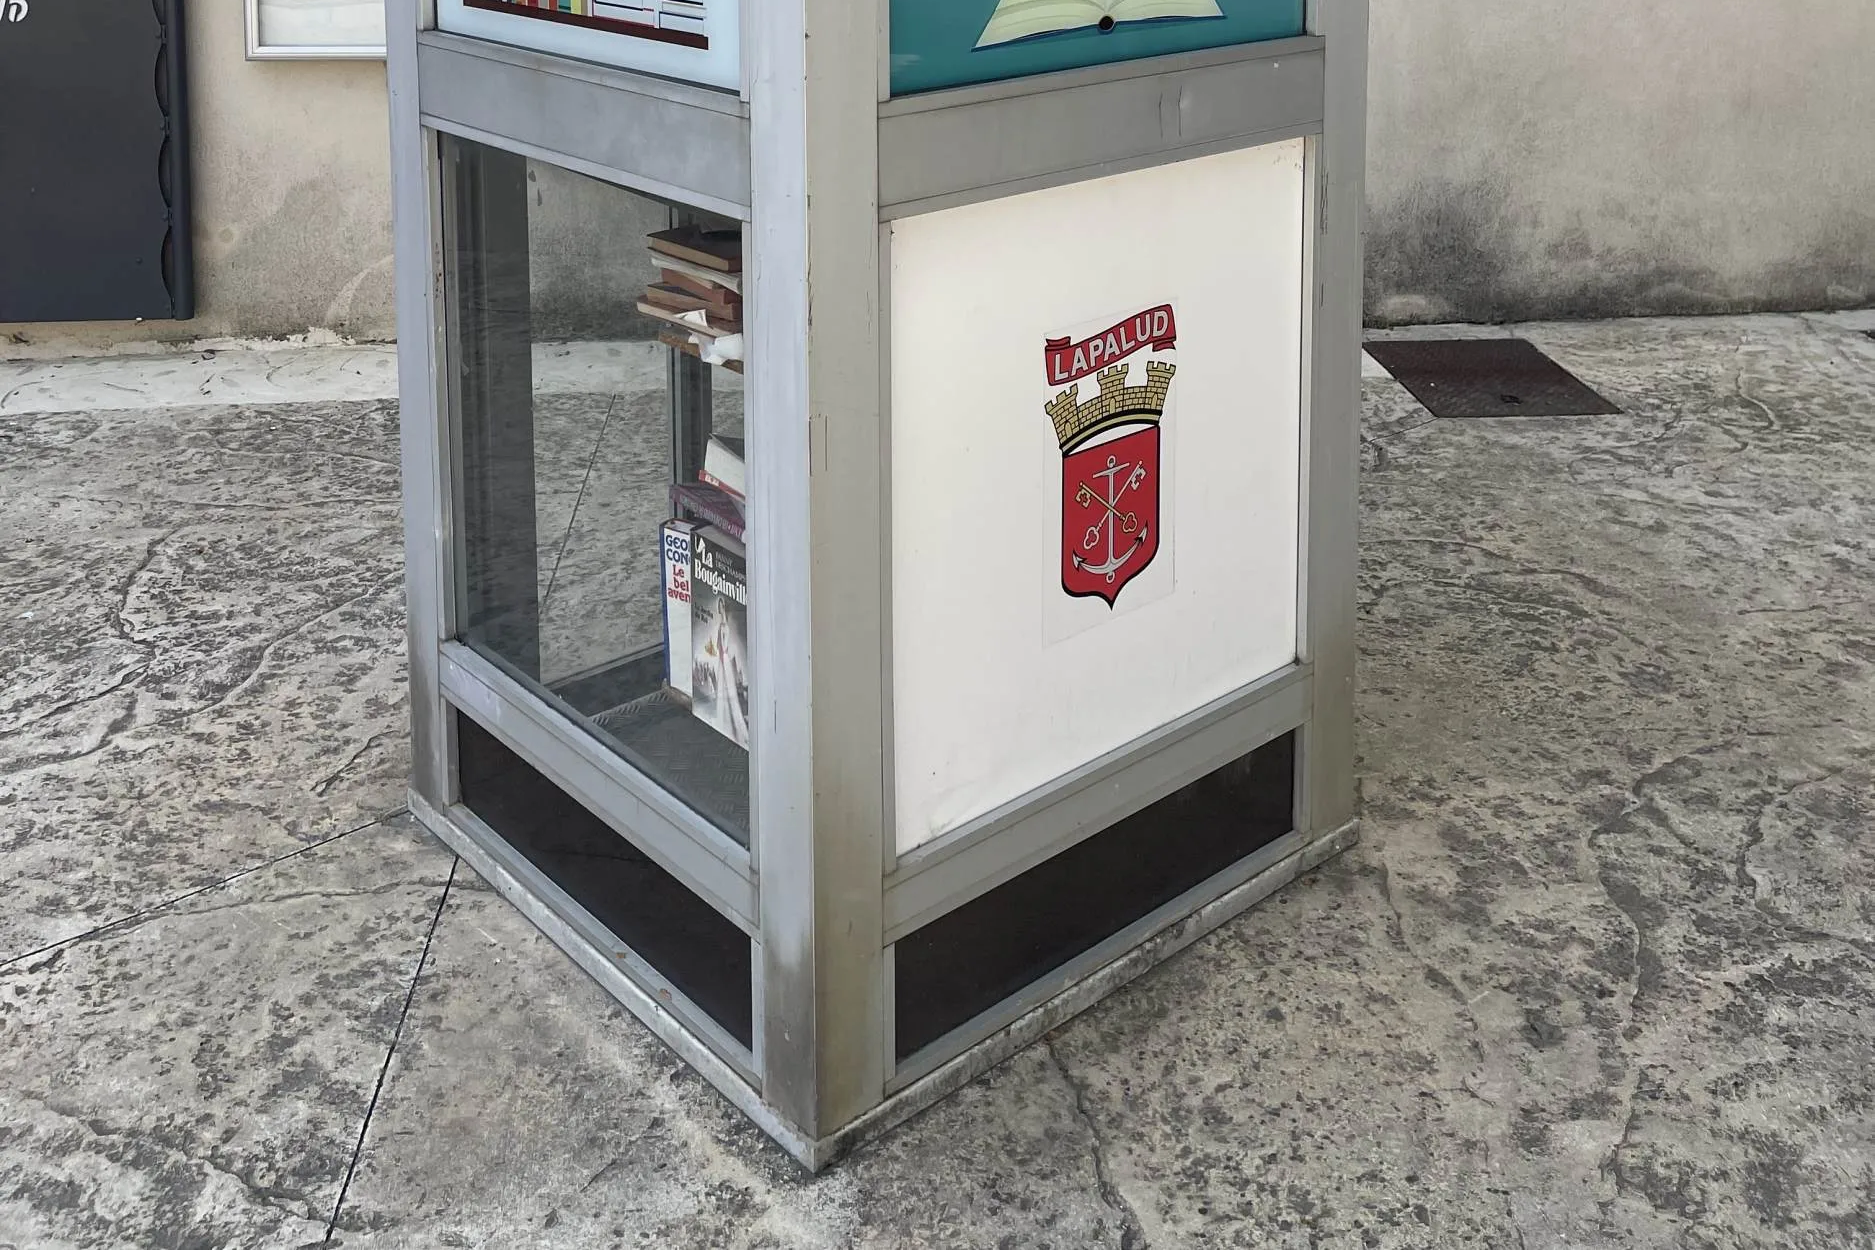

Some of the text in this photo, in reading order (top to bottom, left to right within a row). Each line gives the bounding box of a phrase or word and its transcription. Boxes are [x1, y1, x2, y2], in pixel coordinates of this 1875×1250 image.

[1054, 310, 1169, 381] LAPALUD
[665, 534, 690, 550] GEO
[666, 548, 690, 565] CON
[701, 548, 713, 568] La
[672, 564, 685, 578] Le
[673, 577, 689, 592] bel
[694, 558, 747, 605] Bougainvill
[667, 587, 691, 603] aven
